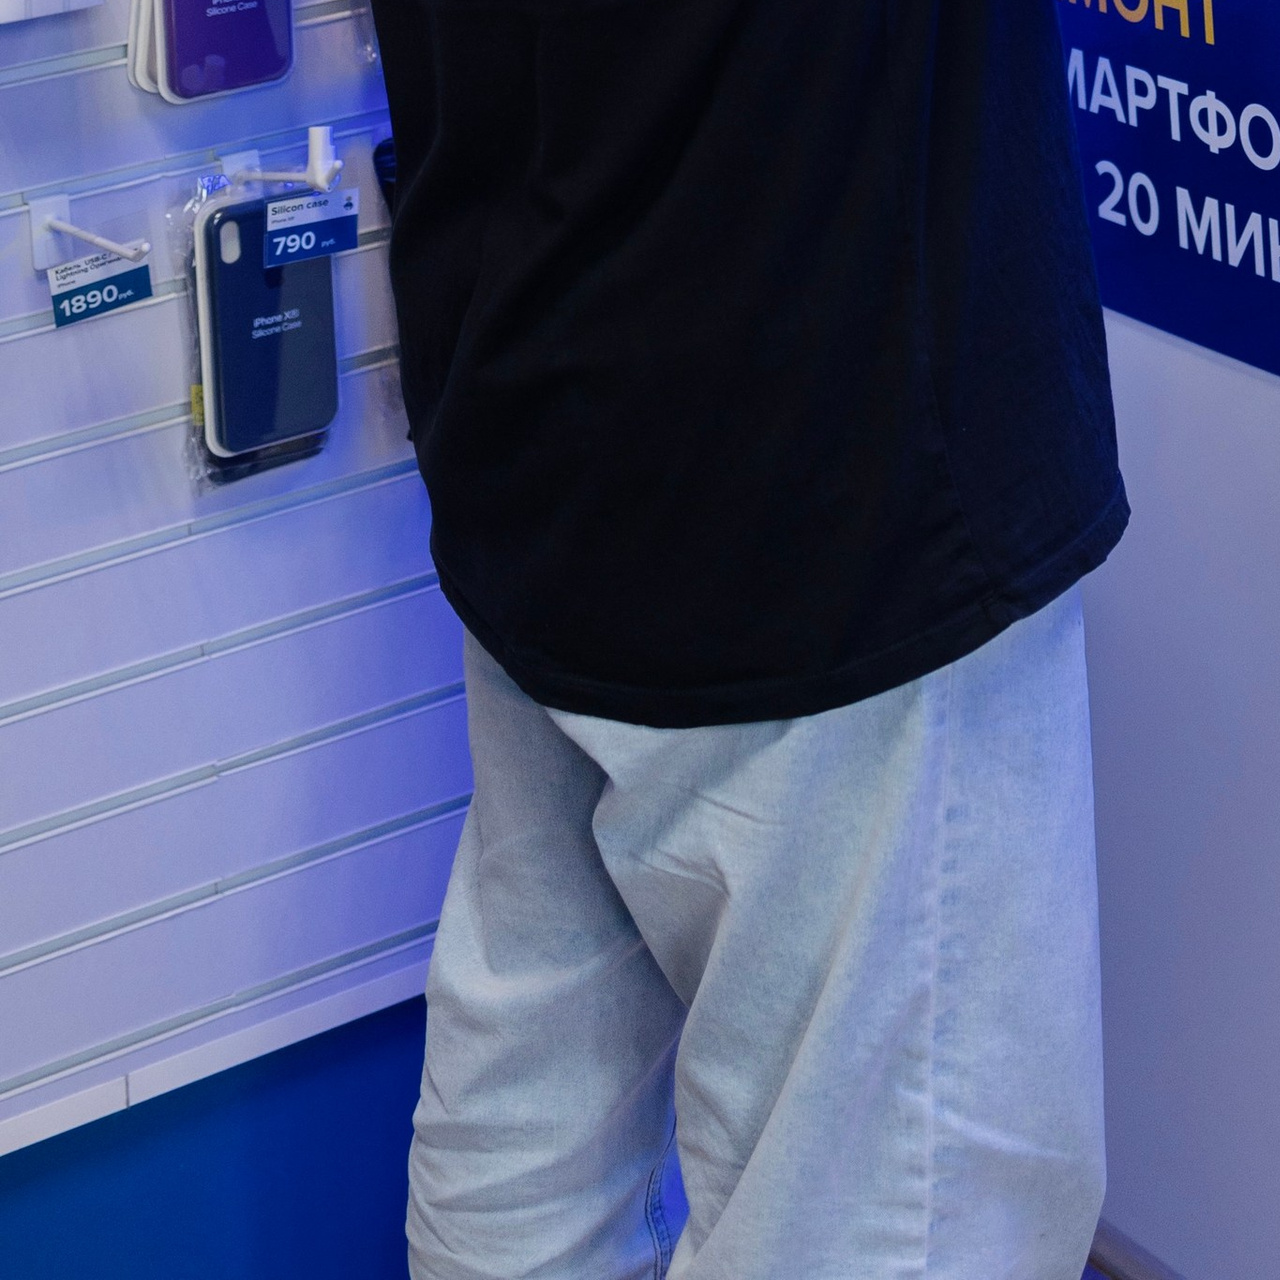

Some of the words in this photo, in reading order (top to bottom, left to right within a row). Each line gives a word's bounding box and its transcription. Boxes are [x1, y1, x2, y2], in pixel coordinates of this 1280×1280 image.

[271, 204, 304, 216] Silicon
[306, 199, 329, 209] case
[1094, 160, 1161, 237] 20
[272, 231, 316, 256] 790
[60, 285, 118, 317] 1890
